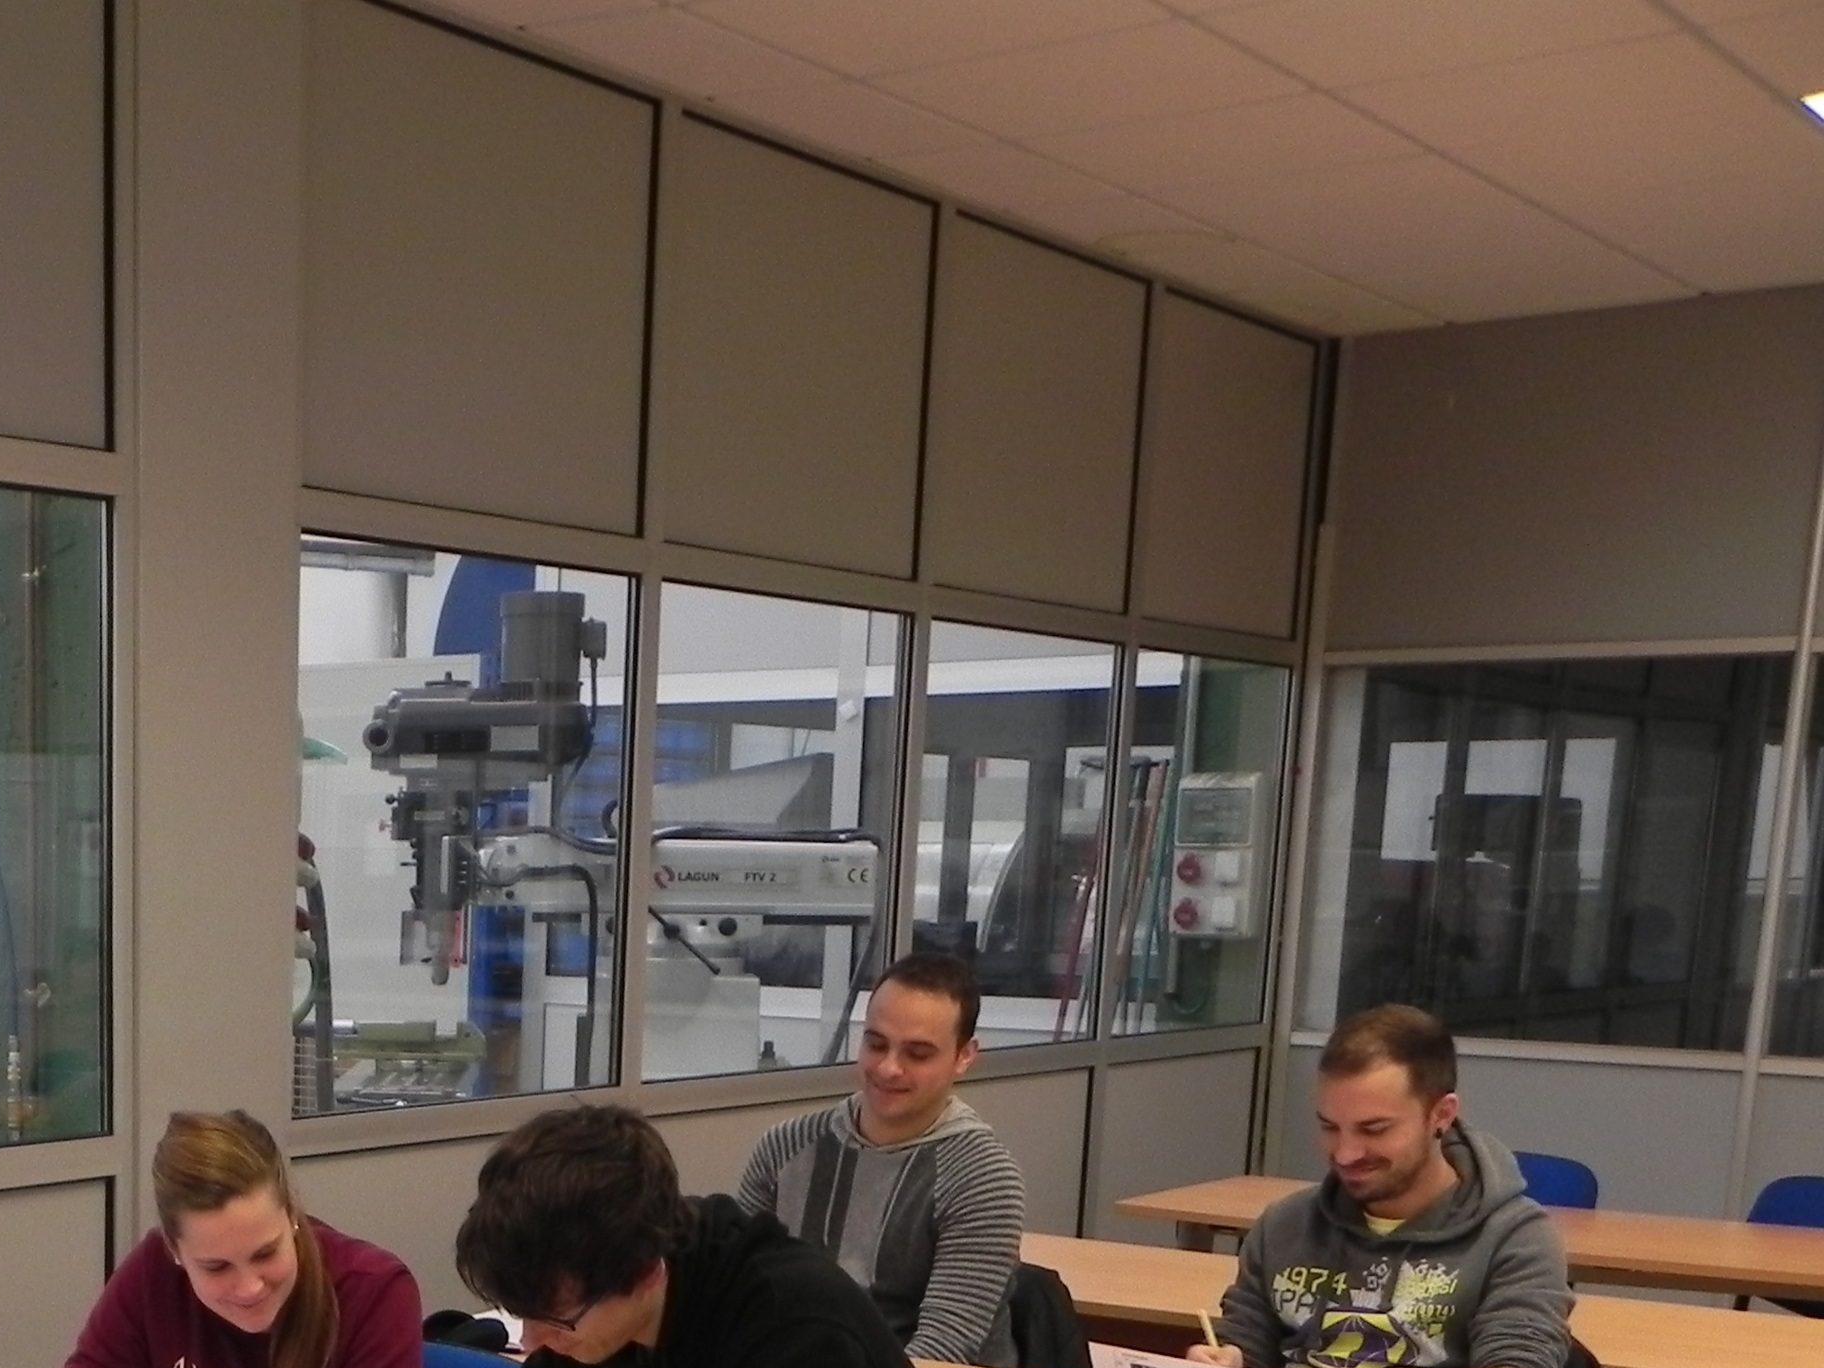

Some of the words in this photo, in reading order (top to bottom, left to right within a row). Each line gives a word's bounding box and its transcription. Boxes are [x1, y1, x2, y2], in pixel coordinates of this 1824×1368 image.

[677, 872, 720, 882] LAGUN
[745, 872, 766, 882] FTV
[769, 872, 777, 882] 2
[1281, 1266, 1348, 1296] 1974
